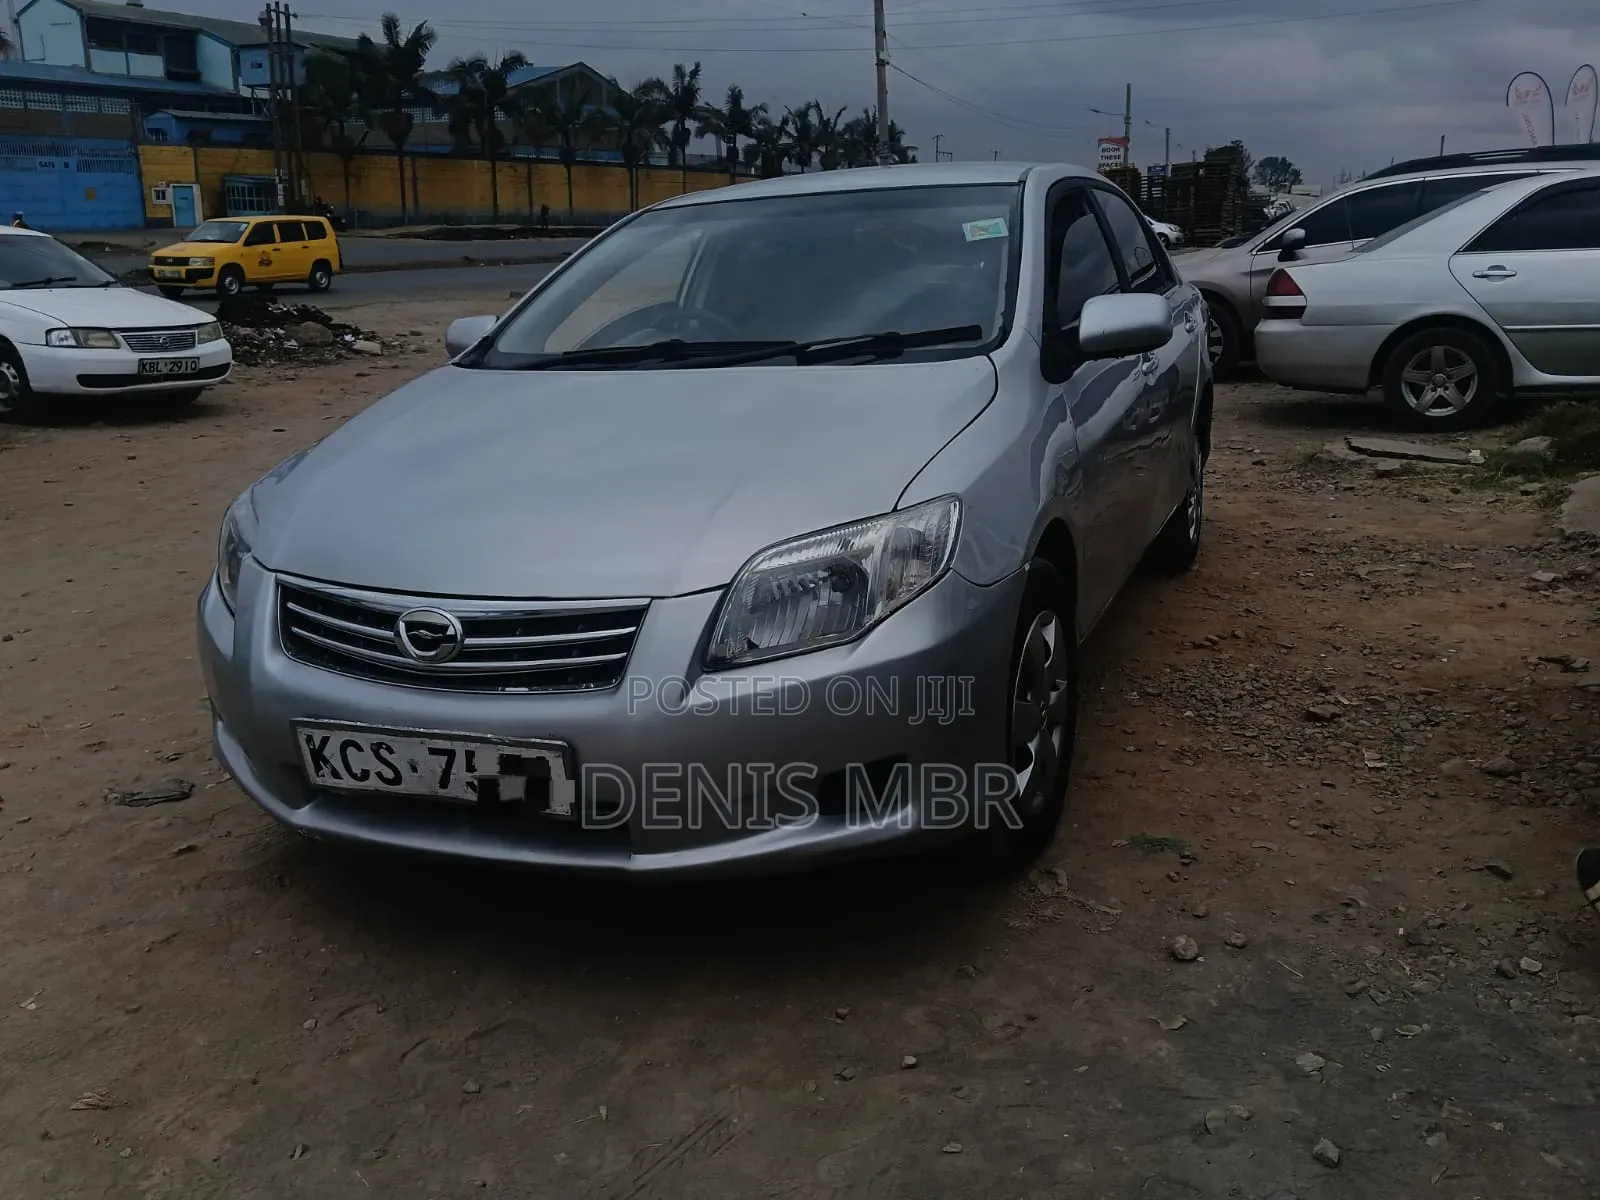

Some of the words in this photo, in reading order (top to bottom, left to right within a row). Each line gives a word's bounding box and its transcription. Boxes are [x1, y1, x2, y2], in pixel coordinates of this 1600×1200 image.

[38, 161, 56, 169] GATE
[141, 361, 163, 373] KBL
[305, 733, 403, 787] KCS
